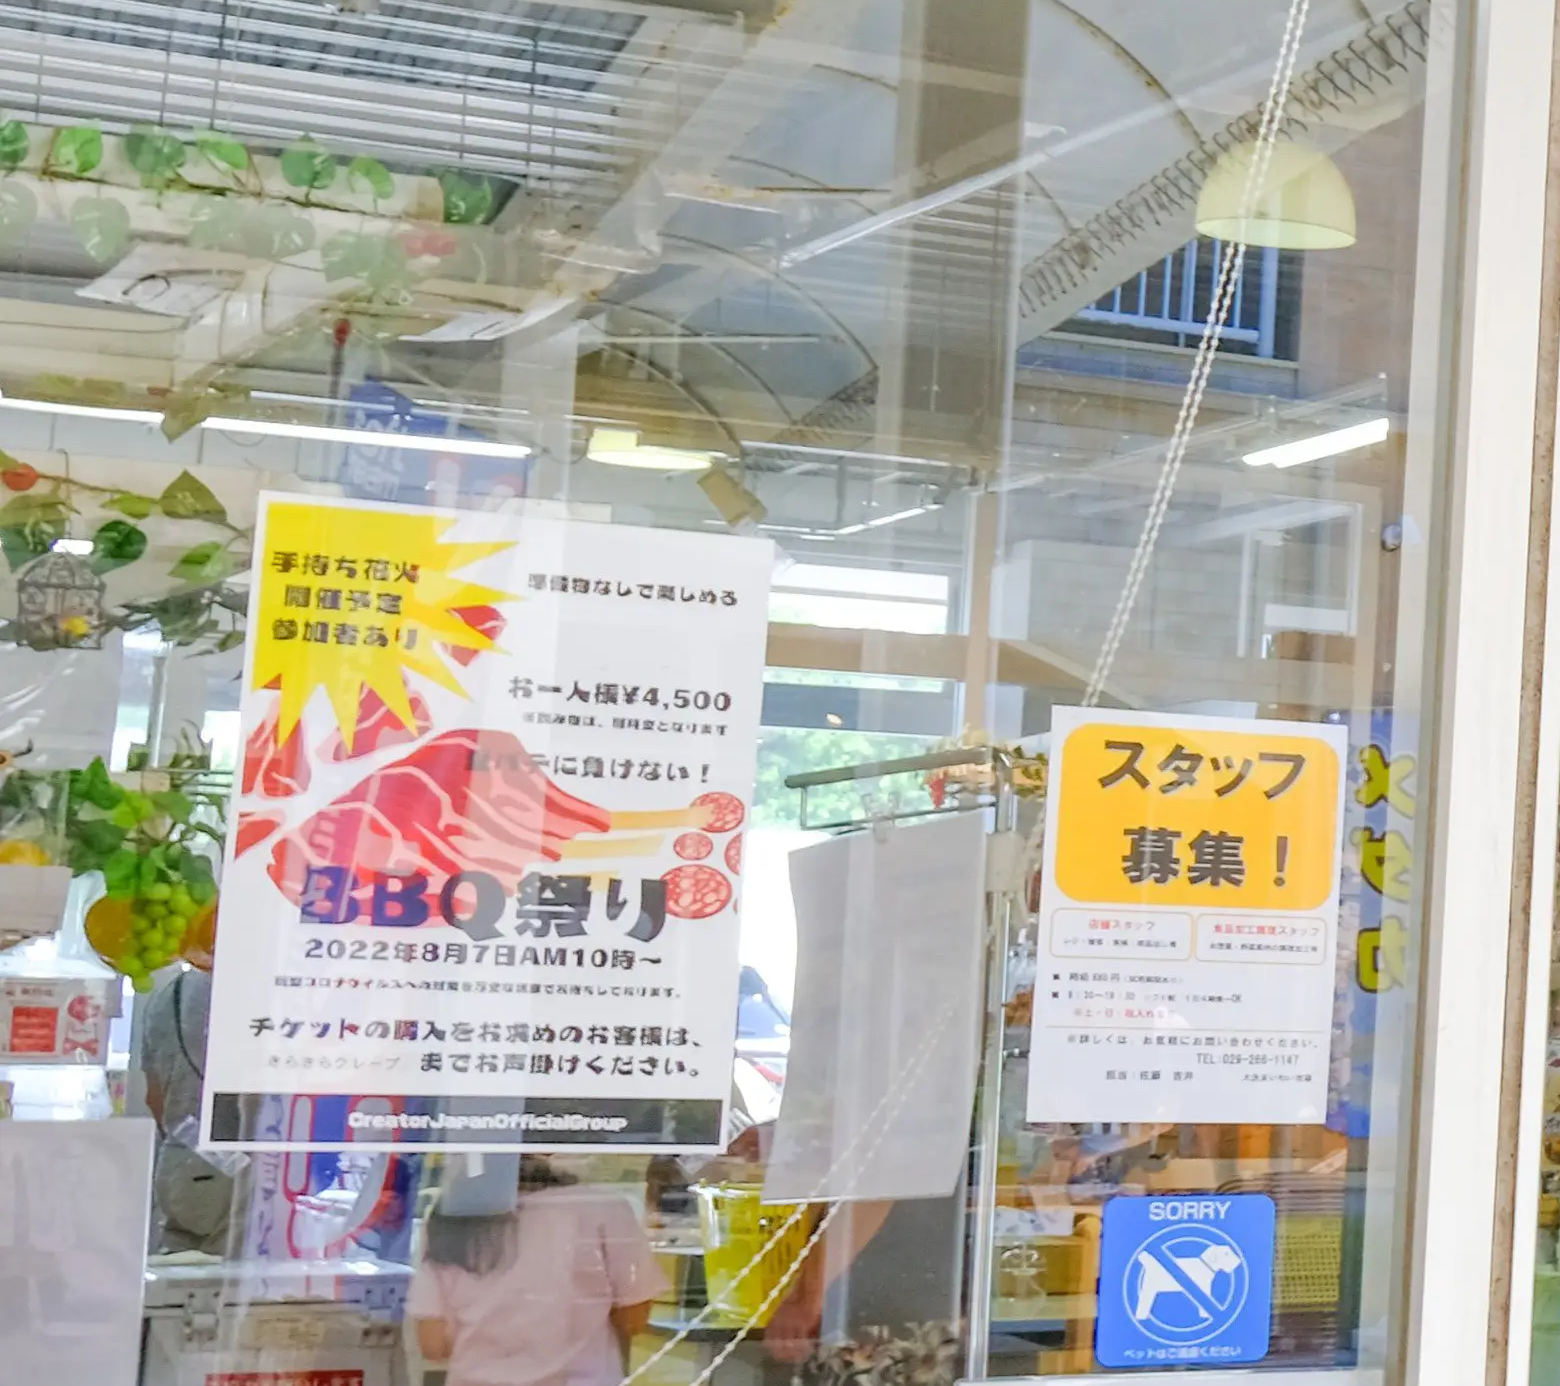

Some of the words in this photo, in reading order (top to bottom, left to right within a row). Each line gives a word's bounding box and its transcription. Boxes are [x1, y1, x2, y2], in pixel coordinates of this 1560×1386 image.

[272, 551, 420, 584] 手持ち花火
[1097, 738, 1307, 800] スタッフ
[1121, 826, 1291, 889] 募集！
[300, 864, 668, 943] BBQ祭り
[1148, 1200, 1231, 1221] SORRY
